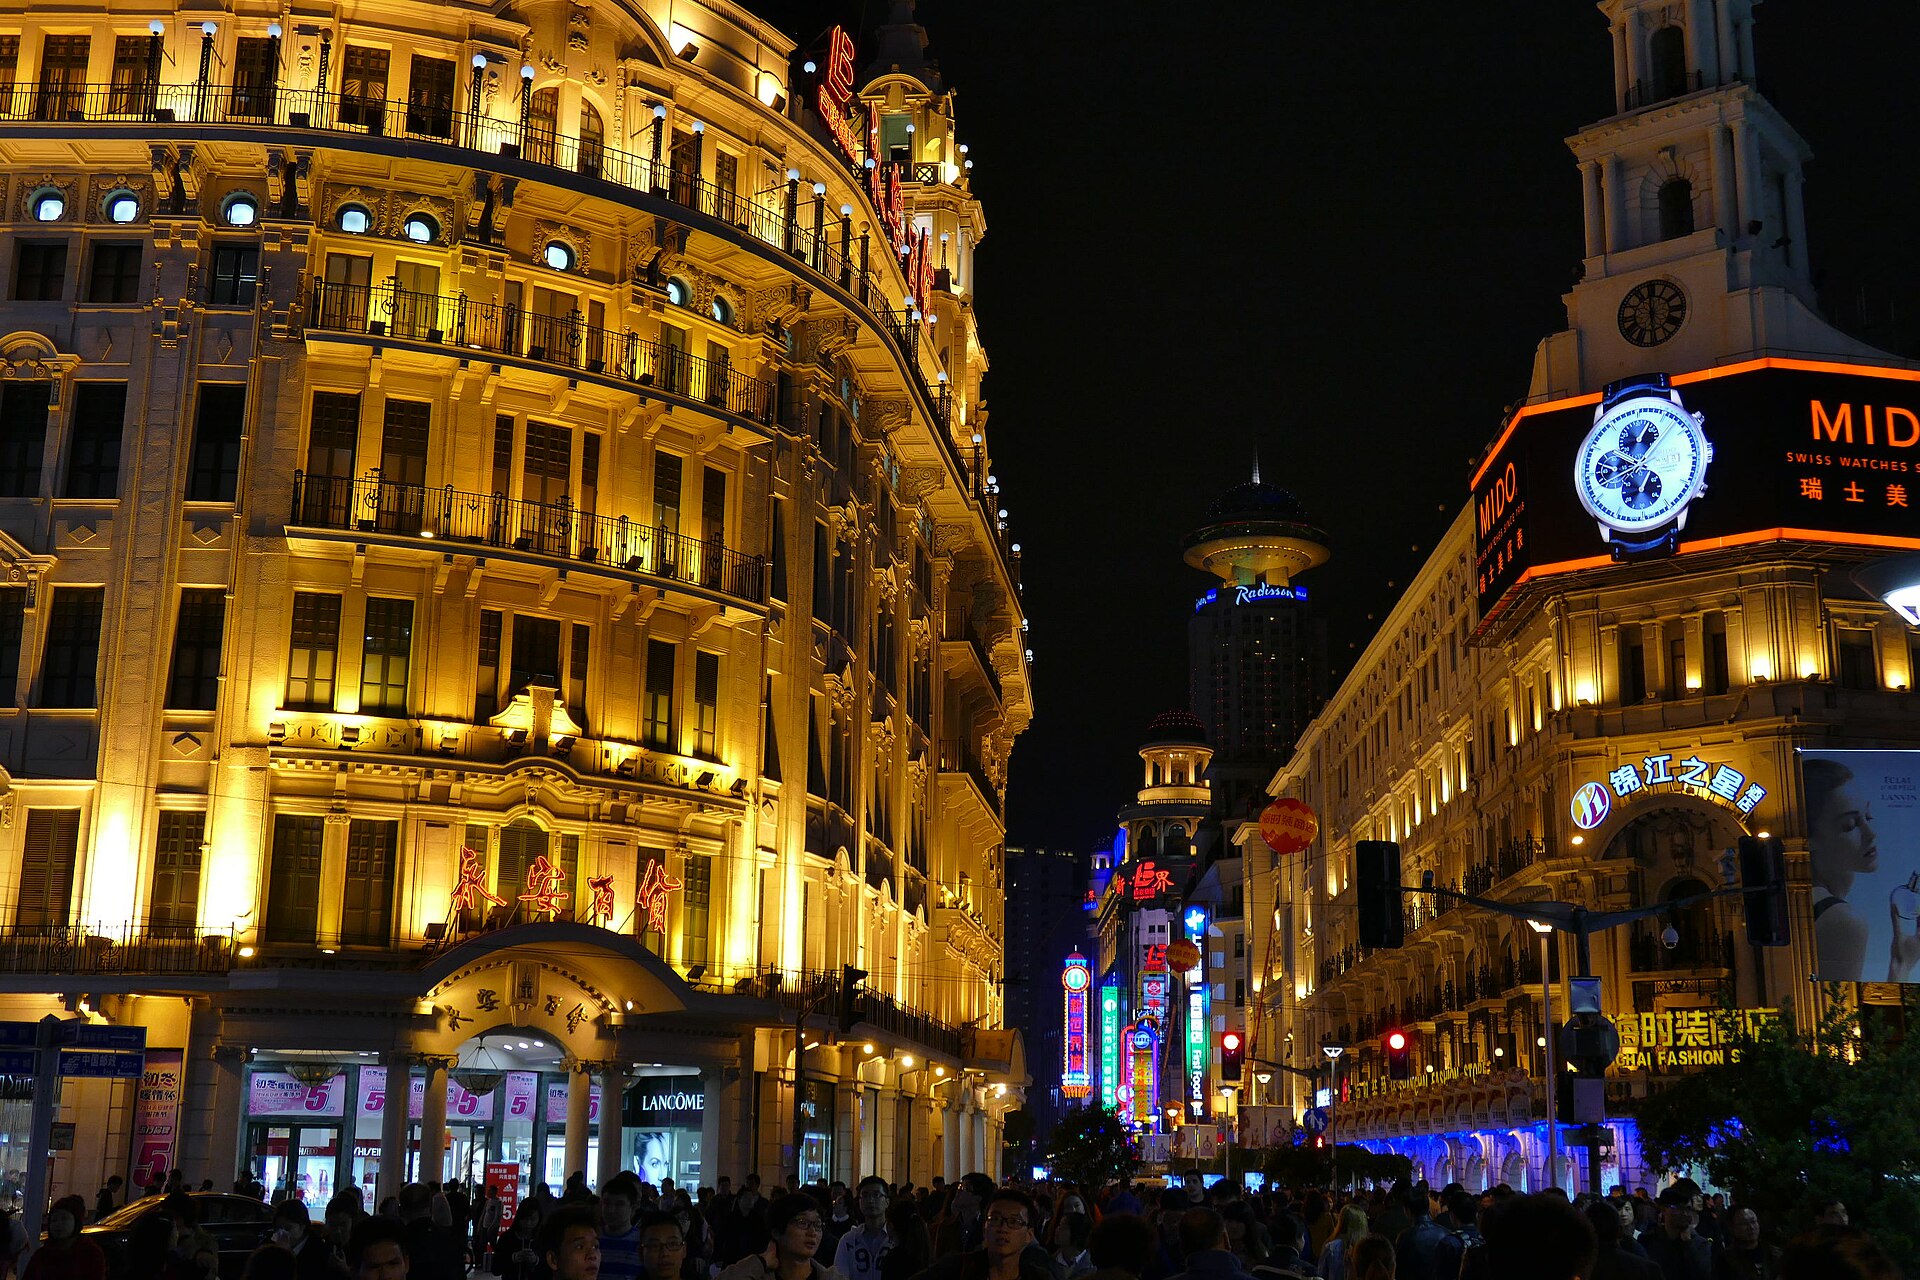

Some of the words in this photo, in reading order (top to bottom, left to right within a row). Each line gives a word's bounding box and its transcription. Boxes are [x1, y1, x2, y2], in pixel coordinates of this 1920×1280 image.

[1810, 399, 1920, 448] MID
[1786, 452, 1831, 465] SWISS
[1839, 457, 1908, 472] WATCHES
[1480, 462, 1516, 539] MIDO
[1799, 477, 1908, 508] 瑞士美
[1235, 582, 1294, 605] Radisson
[1608, 753, 1746, 802] 锦江之星
[1657, 1049, 1725, 1067] FASHION
[305, 1085, 330, 1111] 5
[364, 1091, 385, 1111] 5
[457, 1089, 480, 1115] 5
[510, 1095, 529, 1115] 5
[642, 1091, 704, 1111] LANCÔME
[133, 1141, 173, 1190] 5
[502, 1204, 512, 1220] 5
